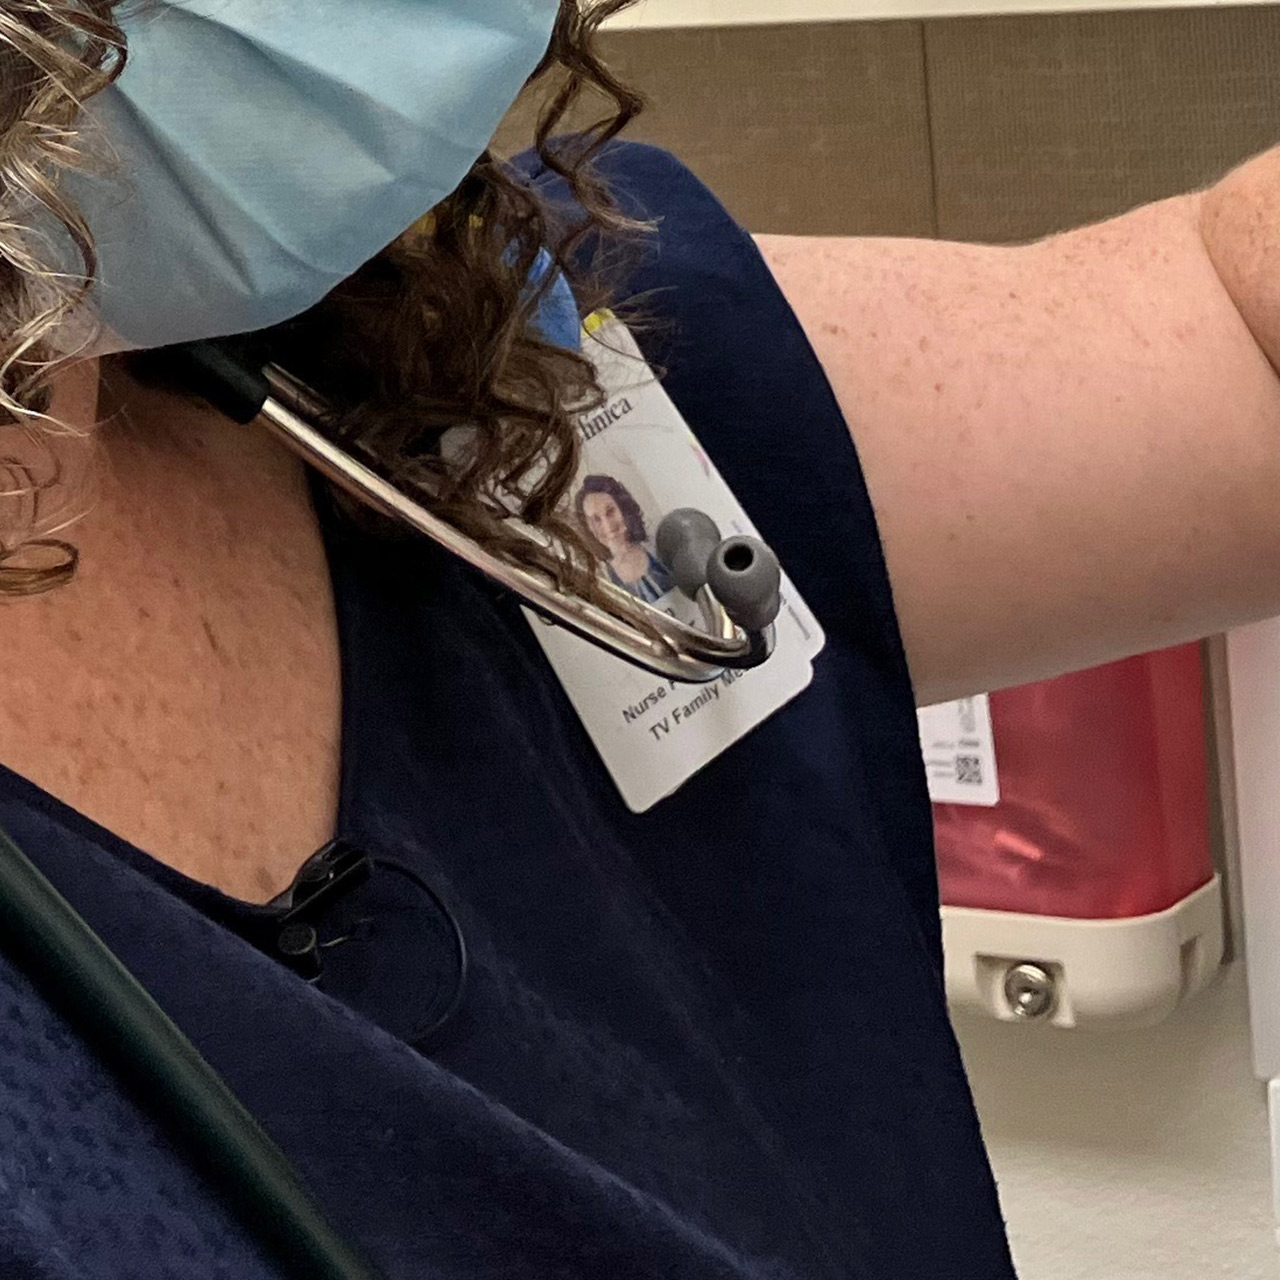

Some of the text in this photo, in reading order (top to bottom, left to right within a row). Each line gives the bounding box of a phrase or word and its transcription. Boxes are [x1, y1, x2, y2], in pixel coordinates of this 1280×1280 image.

[622, 687, 667, 725] Nurse
[649, 717, 671, 741] TV
[672, 686, 720, 724] Family
